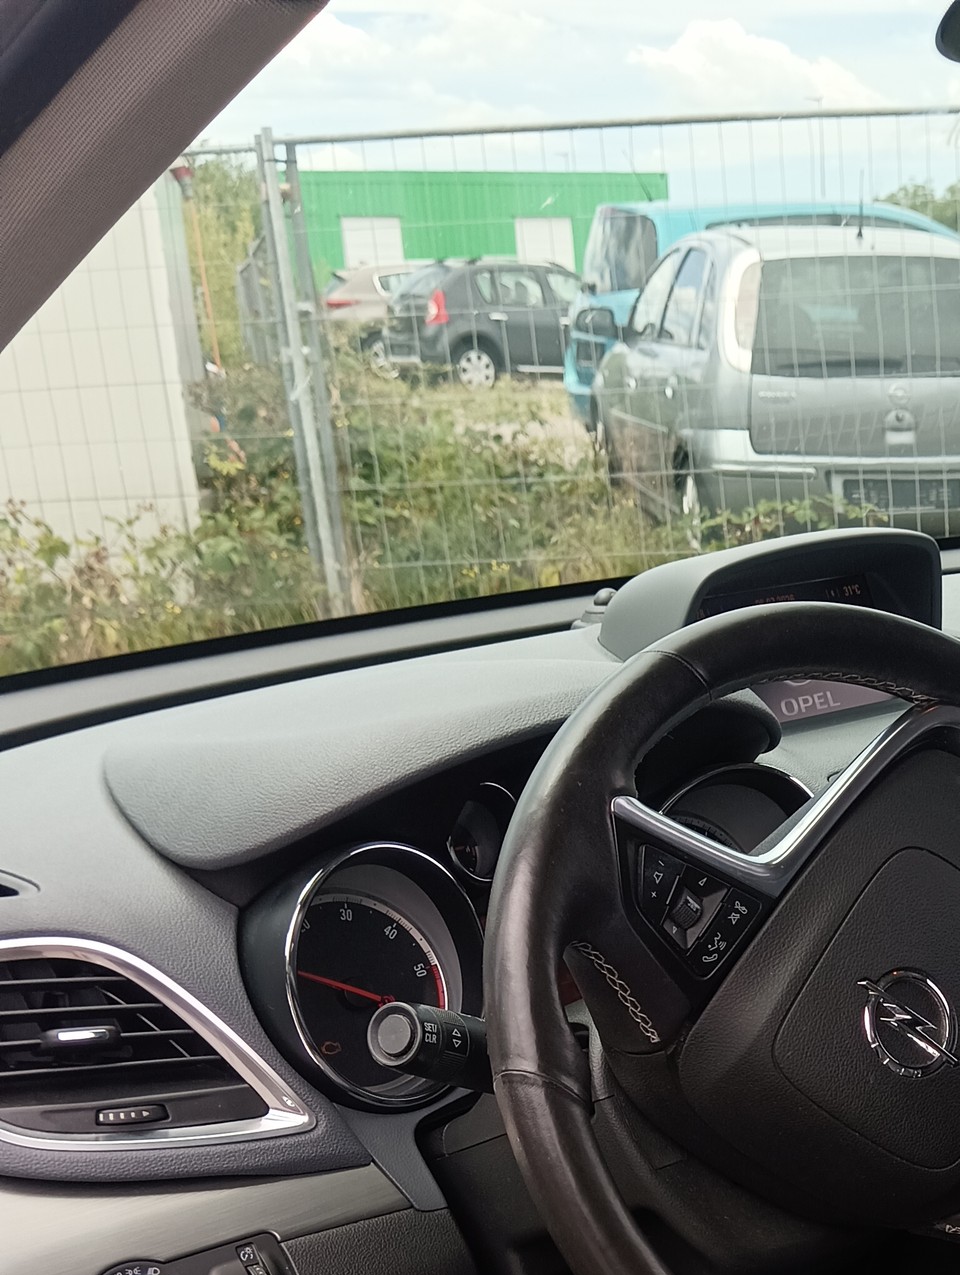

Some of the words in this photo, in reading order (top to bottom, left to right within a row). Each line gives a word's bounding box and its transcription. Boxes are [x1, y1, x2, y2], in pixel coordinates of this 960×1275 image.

[780, 691, 841, 716] OPEL
[339, 909, 353, 922] 30
[384, 924, 398, 940] 40
[413, 963, 428, 978] 50
[425, 1033, 437, 1044] CLR
